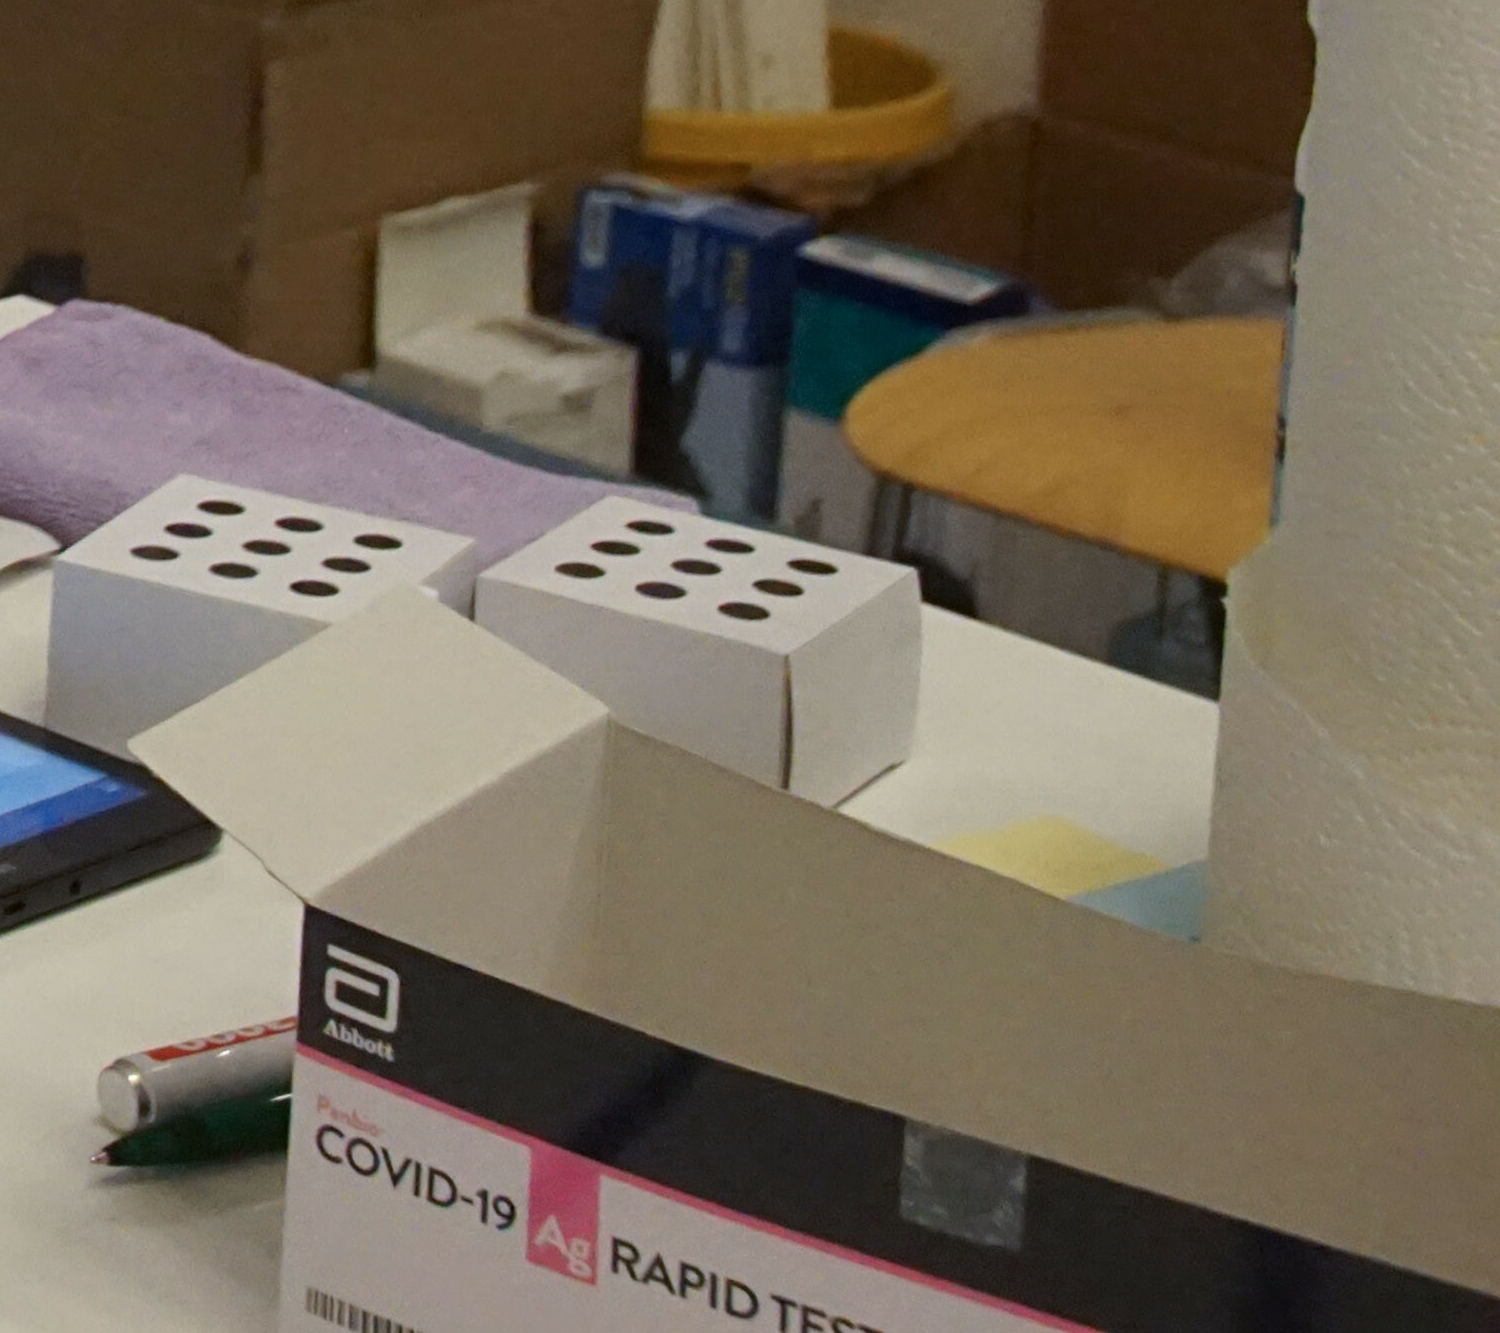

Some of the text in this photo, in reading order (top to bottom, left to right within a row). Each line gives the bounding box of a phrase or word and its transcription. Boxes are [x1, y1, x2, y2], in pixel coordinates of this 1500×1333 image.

[322, 1018, 395, 1063] Abbott
[315, 1123, 517, 1231] COVID-19
[534, 1215, 593, 1278] Ag
[610, 1237, 759, 1320] RAPID
